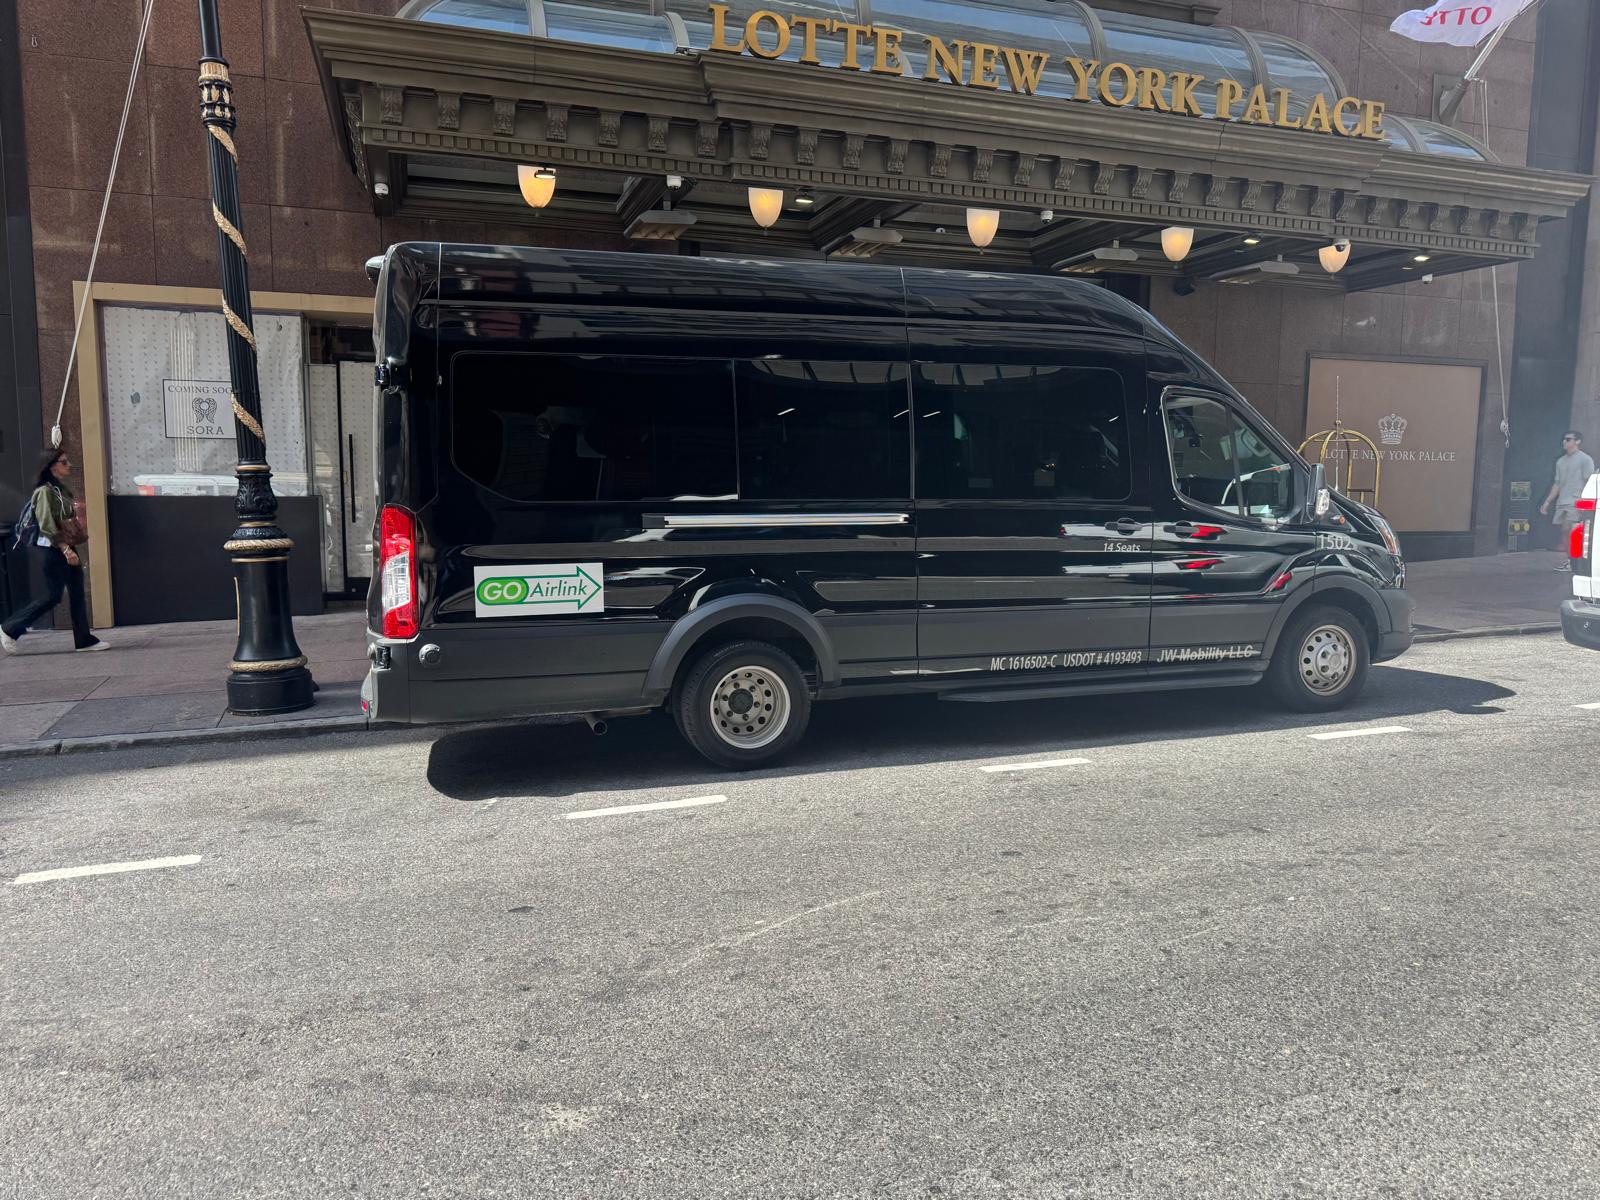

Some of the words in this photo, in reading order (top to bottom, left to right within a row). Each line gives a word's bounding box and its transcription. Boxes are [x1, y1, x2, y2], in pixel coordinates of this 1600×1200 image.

[707, 4, 903, 76] LOTTE
[922, 35, 1051, 97] NEW
[1065, 56, 1205, 118] YORK
[1215, 79, 1387, 141] PALACE
[168, 385, 210, 394] COMING
[212, 386, 232, 394] SOO
[186, 425, 224, 435] SORA
[1389, 450, 1417, 461] YORK
[1419, 451, 1456, 462] PALACE
[1104, 542, 1115, 552] 14
[1116, 542, 1141, 553] Seats
[1320, 534, 1352, 550] 1502
[483, 581, 522, 600] GO
[530, 579, 588, 598] Airlink
[990, 657, 1006, 671] MC
[1008, 654, 1058, 670] 1616502-C
[1063, 652, 1096, 667] USDOT
[1103, 651, 1142, 665] 4193493
[1157, 649, 1178, 663] JW
[1179, 646, 1226, 662] Mobility
[1229, 645, 1254, 659] LLC
